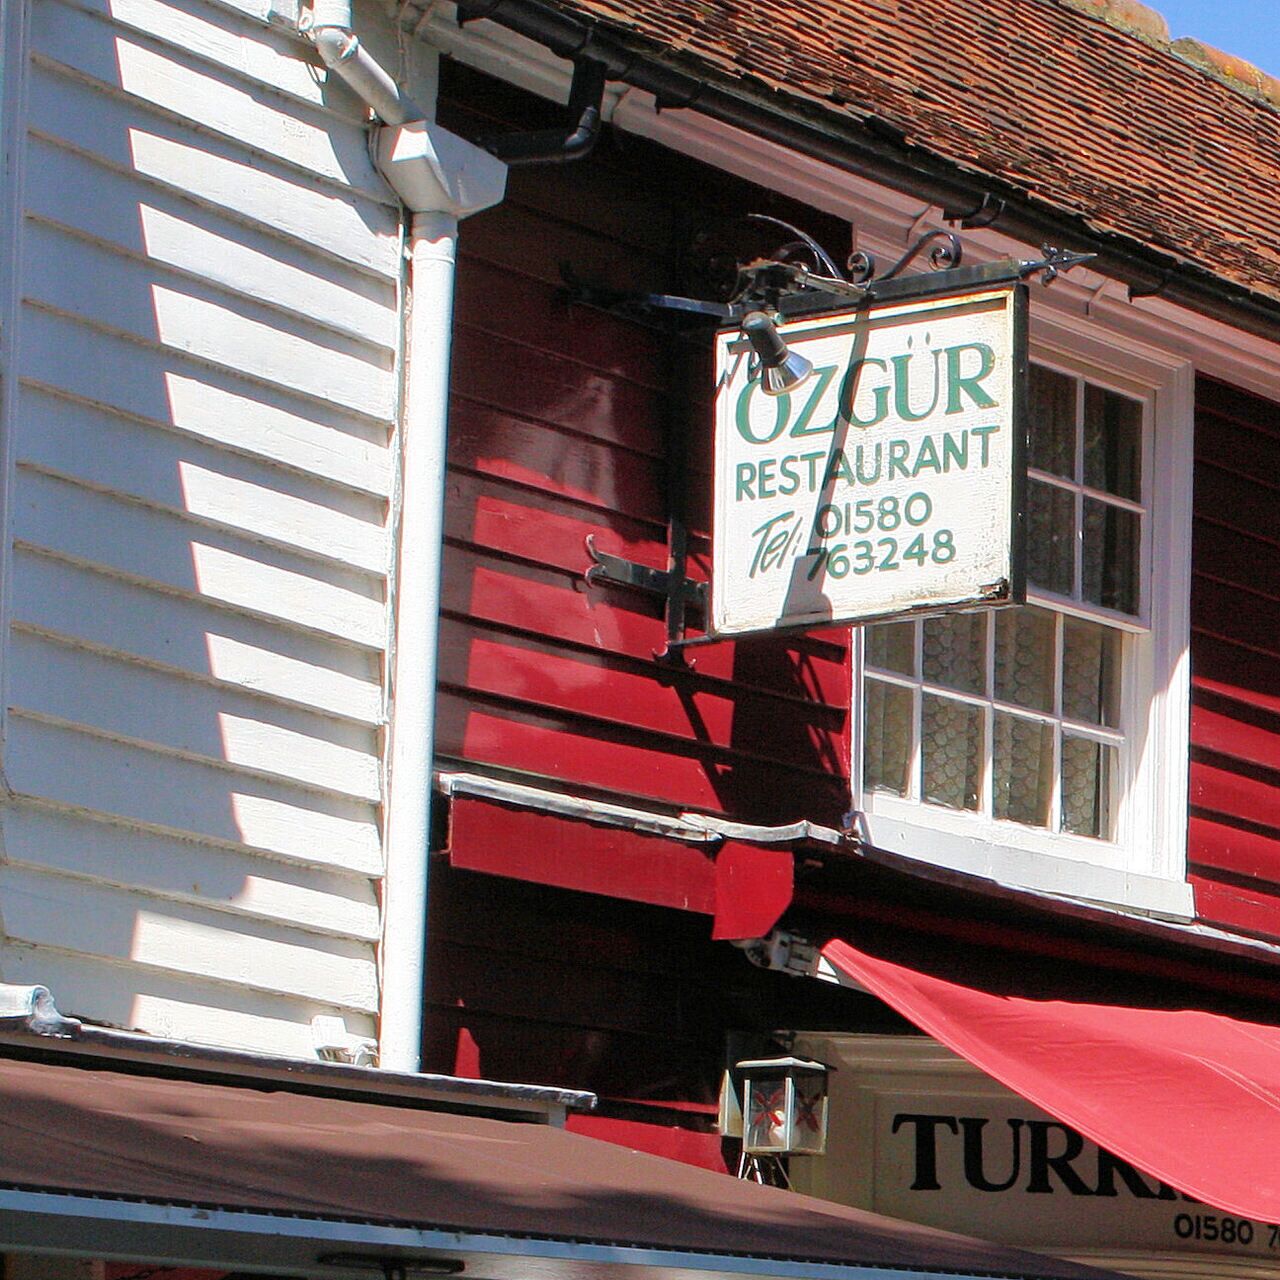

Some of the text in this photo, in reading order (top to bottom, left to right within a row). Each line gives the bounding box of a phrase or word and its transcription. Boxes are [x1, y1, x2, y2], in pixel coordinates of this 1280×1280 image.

[736, 425, 1000, 501] RESTAURANT
[816, 492, 932, 540] 01580
[806, 528, 956, 582] 763248
[1173, 1213, 1254, 1245] 01580
